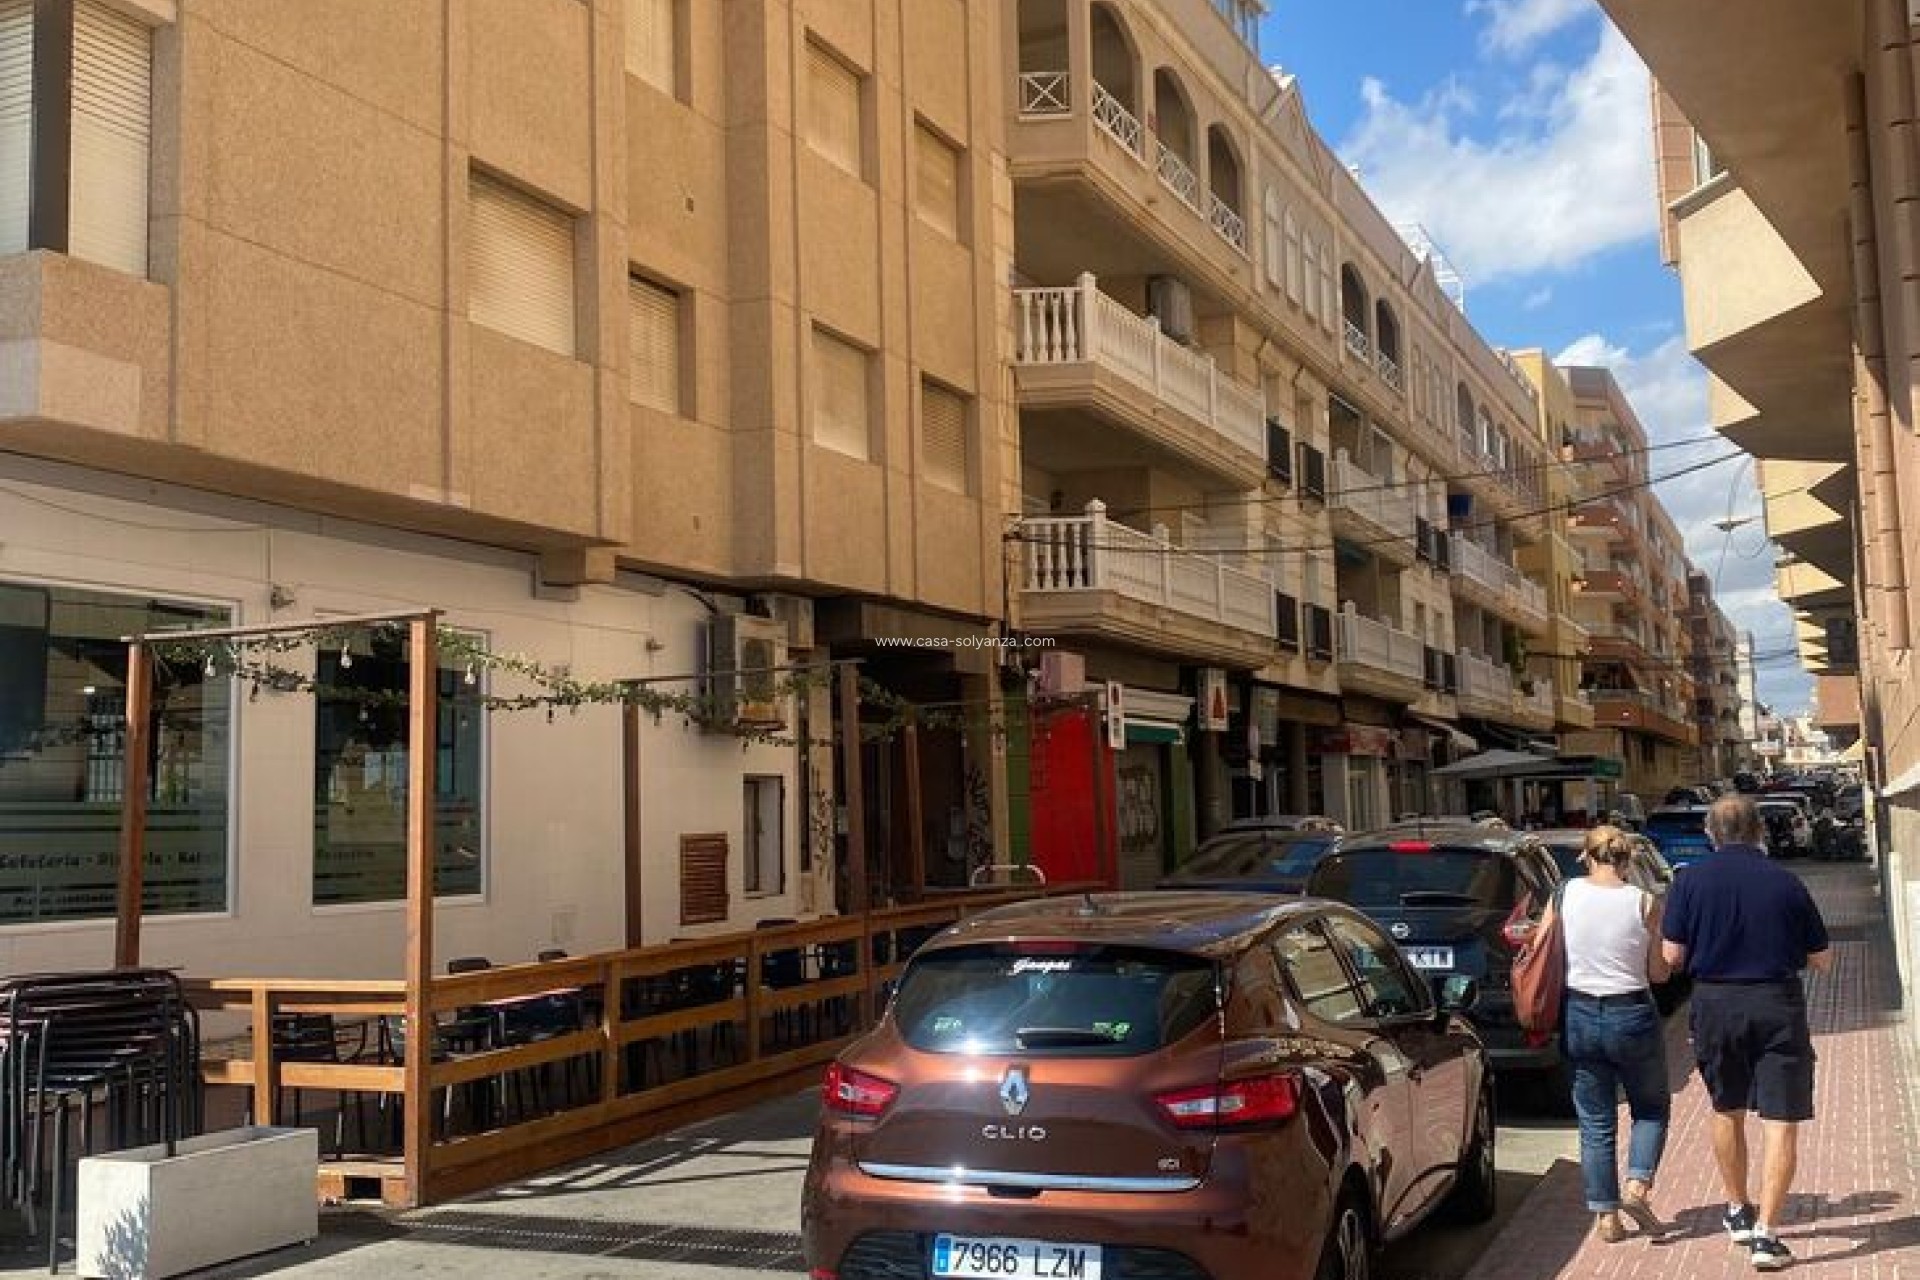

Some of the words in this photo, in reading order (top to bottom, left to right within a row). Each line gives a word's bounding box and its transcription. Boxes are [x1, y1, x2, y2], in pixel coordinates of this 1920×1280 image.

[981, 1124, 1047, 1141] CLIO
[952, 1242, 1018, 1275] 7966
[1034, 1245, 1086, 1279] LZM
